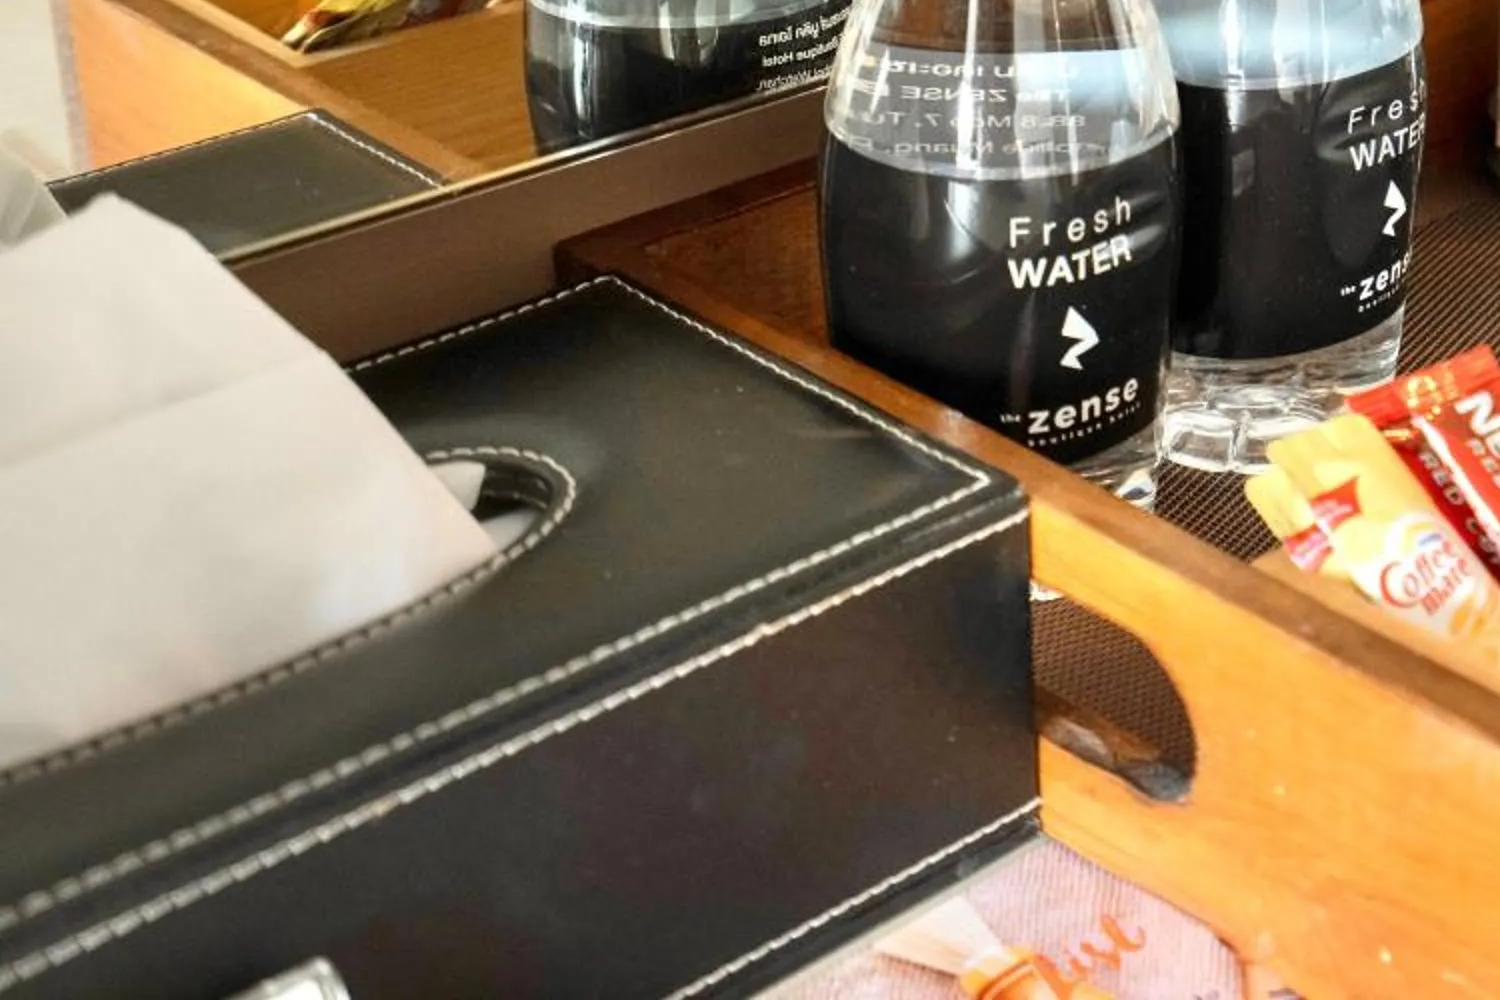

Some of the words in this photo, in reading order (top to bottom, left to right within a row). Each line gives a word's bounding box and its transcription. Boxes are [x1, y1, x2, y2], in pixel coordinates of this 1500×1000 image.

[1349, 111, 1426, 171] WATER
[1009, 197, 1131, 249] Fresh
[1008, 235, 1133, 290] WATER
[1359, 250, 1411, 301] zens
[1027, 377, 1139, 435] zense
